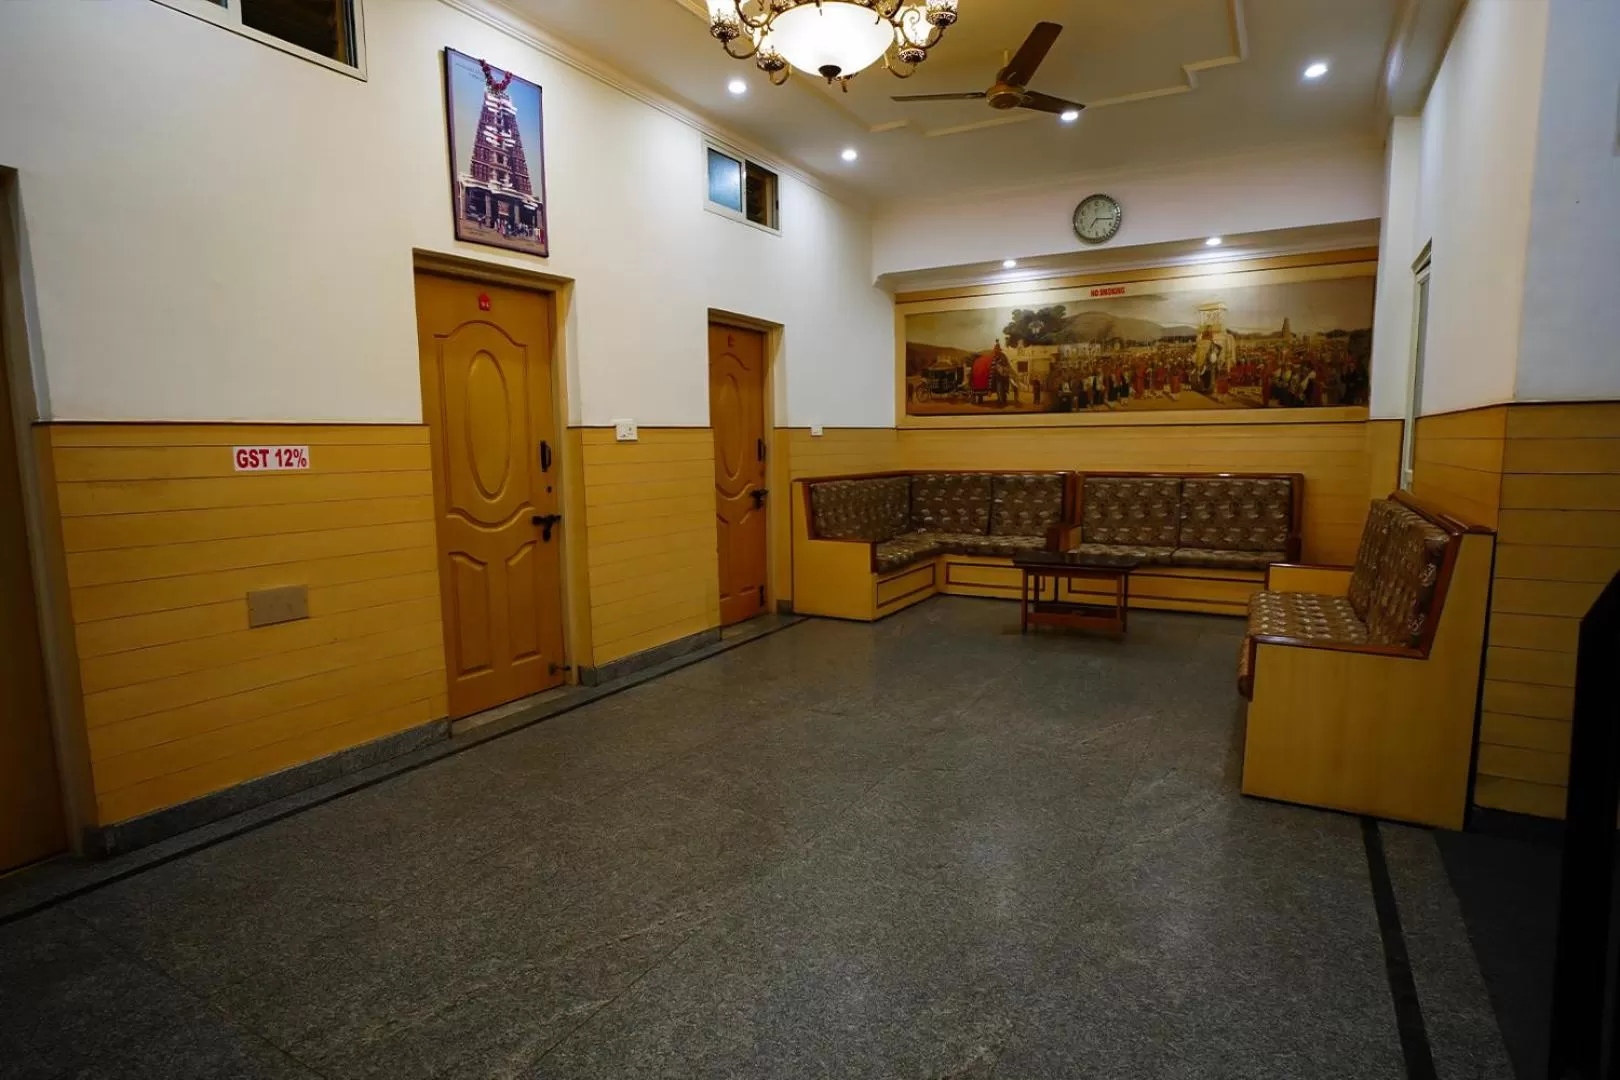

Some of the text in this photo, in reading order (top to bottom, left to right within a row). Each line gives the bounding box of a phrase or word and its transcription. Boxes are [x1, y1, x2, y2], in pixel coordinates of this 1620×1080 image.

[1091, 286, 1125, 297] NO SMOKING
[236, 448, 307, 468] GST 12%
